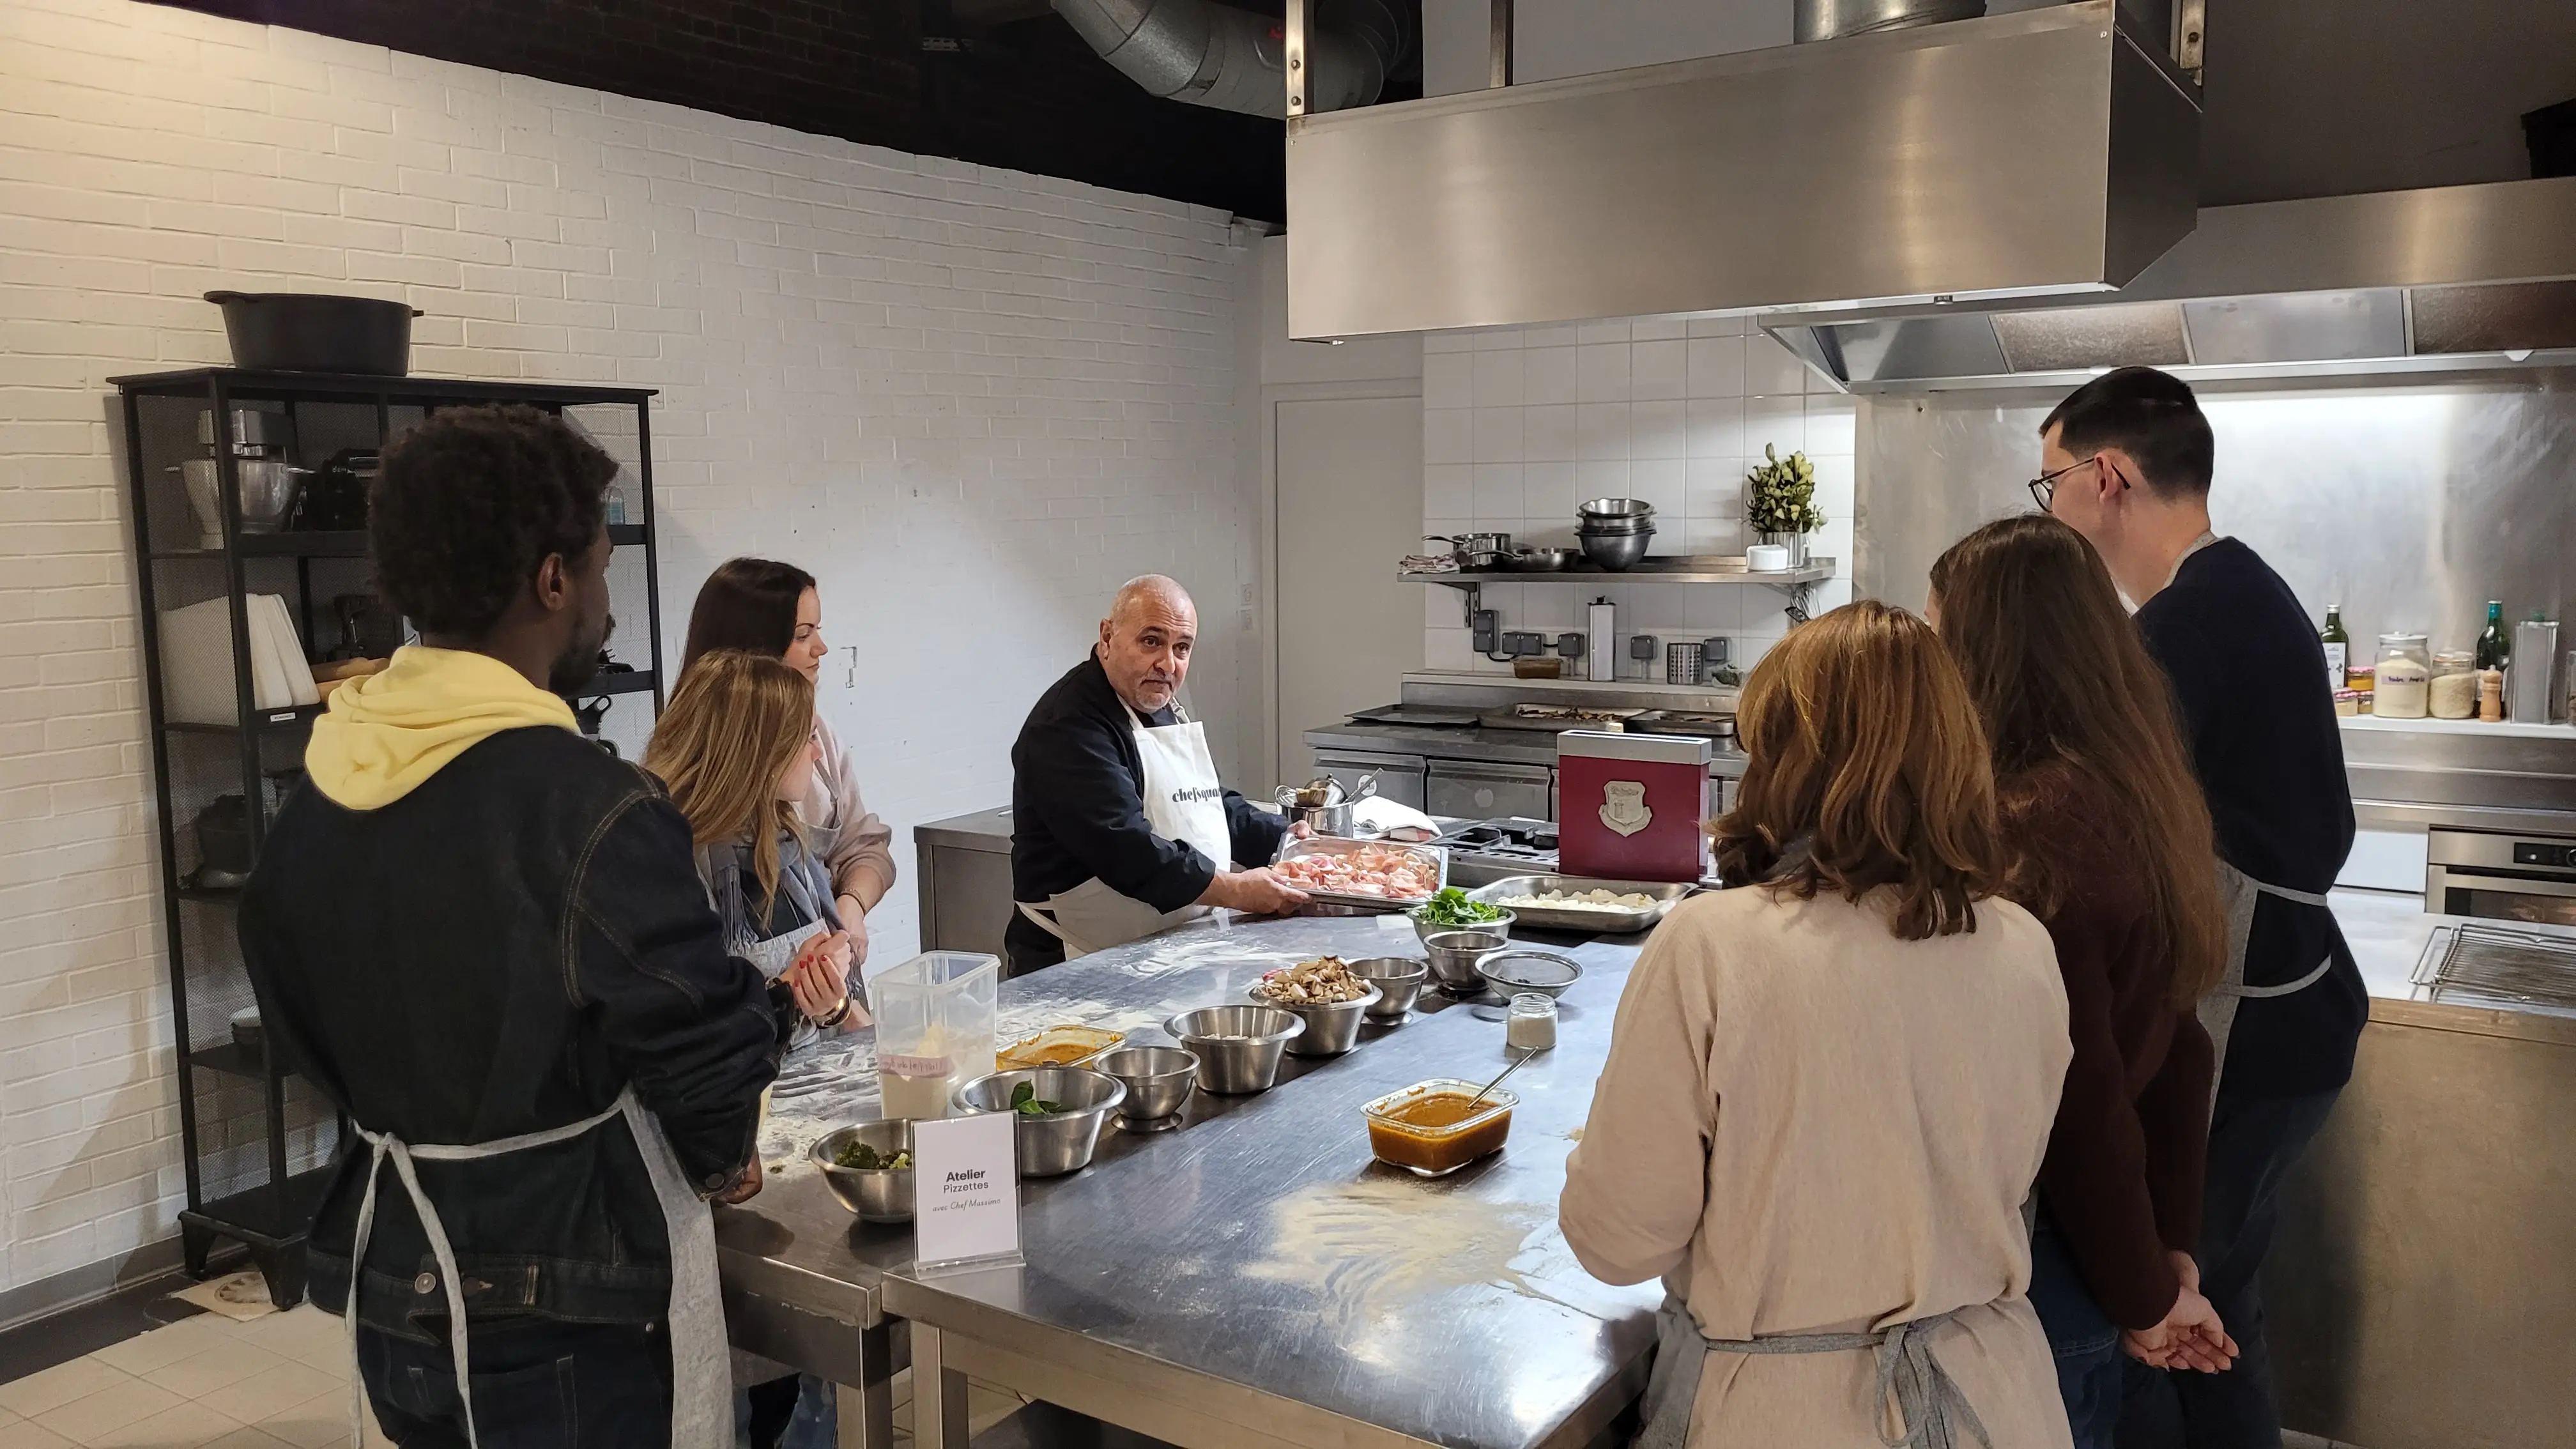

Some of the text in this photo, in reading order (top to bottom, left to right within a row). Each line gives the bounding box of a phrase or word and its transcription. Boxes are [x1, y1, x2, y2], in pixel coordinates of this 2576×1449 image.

[946, 1169, 986, 1183] Atelier
[943, 1182, 989, 1194] Pizzettes
[950, 1199, 969, 1211] Chef
[969, 1199, 1001, 1208] Massimo
